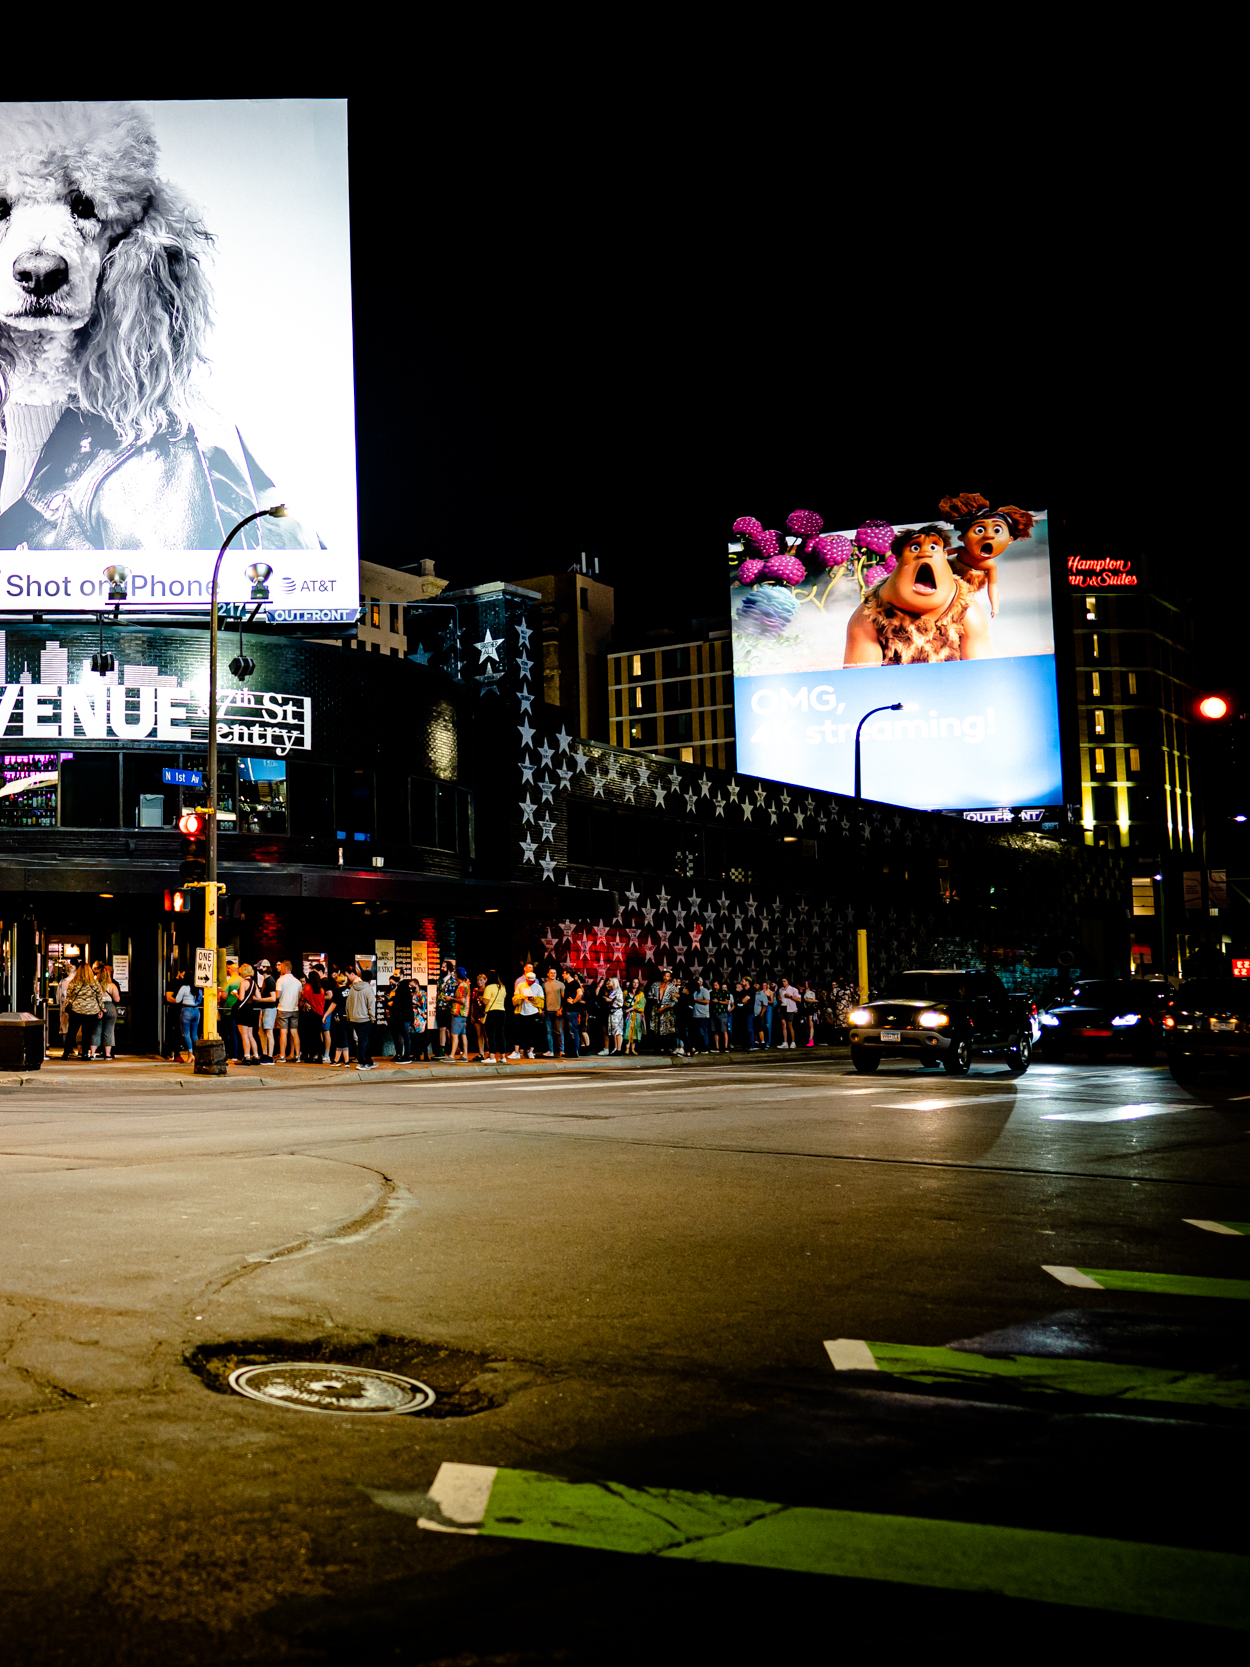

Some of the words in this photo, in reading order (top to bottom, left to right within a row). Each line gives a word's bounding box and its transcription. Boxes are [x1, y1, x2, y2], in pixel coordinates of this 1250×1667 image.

[1067, 555, 1131, 574] Hampton
[6, 574, 72, 597] Shot
[300, 579, 337, 592] AT&T
[1089, 576, 1101, 588] &
[1097, 572, 1138, 587] Suites
[217, 603, 245, 617] 217
[274, 609, 350, 622] OUTFRONT
[480, 640, 498, 649] BROTHER
[216, 688, 255, 719] 7th
[261, 692, 299, 724] St
[750, 685, 846, 716] OMG,
[750, 719, 799, 747] 4K
[805, 707, 997, 745] streaming!
[216, 722, 300, 756] entry
[165, 771, 171, 780] N
[175, 772, 186, 783] 1st
[190, 773, 200, 784] Av
[966, 811, 1040, 822] OUTFRNT
[198, 952, 212, 961] ONE
[197, 963, 212, 972] WAY
